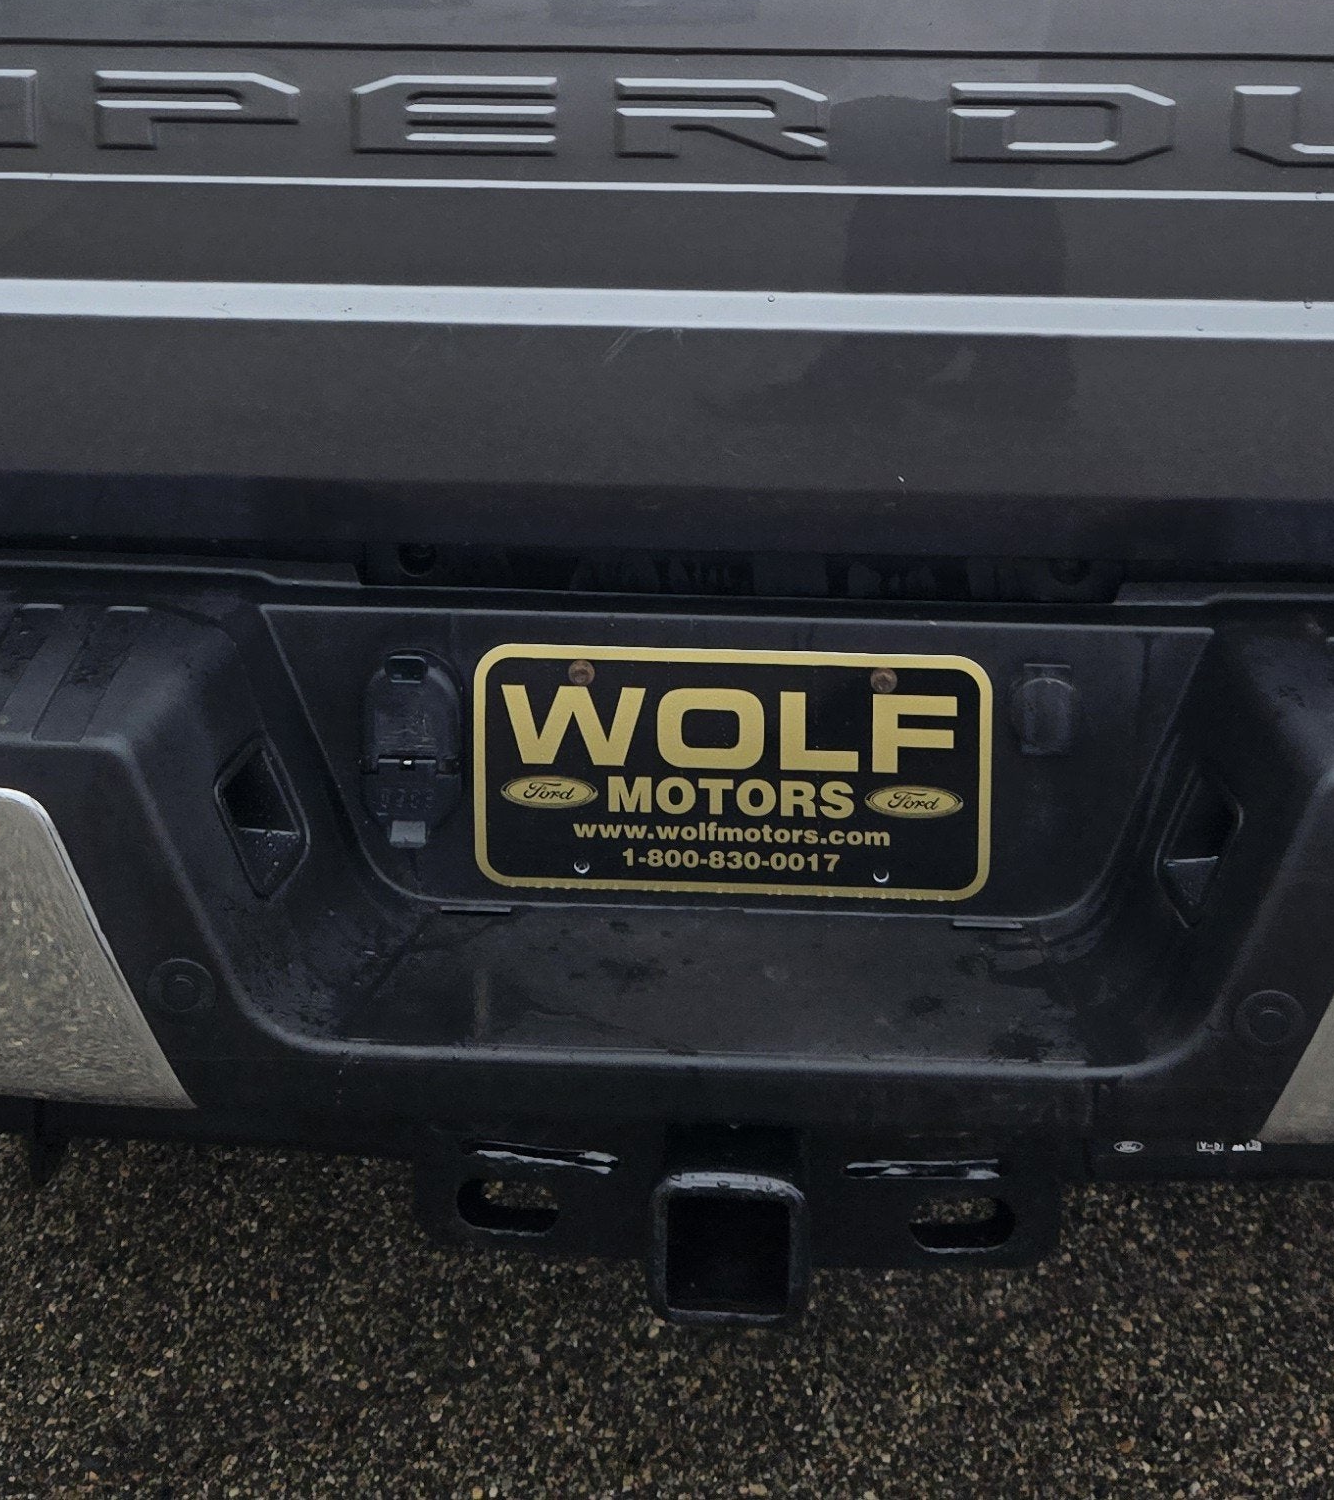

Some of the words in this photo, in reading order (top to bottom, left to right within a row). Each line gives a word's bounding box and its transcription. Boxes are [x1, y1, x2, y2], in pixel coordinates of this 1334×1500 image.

[501, 684, 958, 774] WOLF
[522, 781, 574, 802] Ford
[607, 776, 855, 819] MOTORS
[887, 791, 940, 812] Ford
[573, 822, 891, 847] www.wolfmotors.com
[622, 849, 840, 873] 1-800-830-0017
